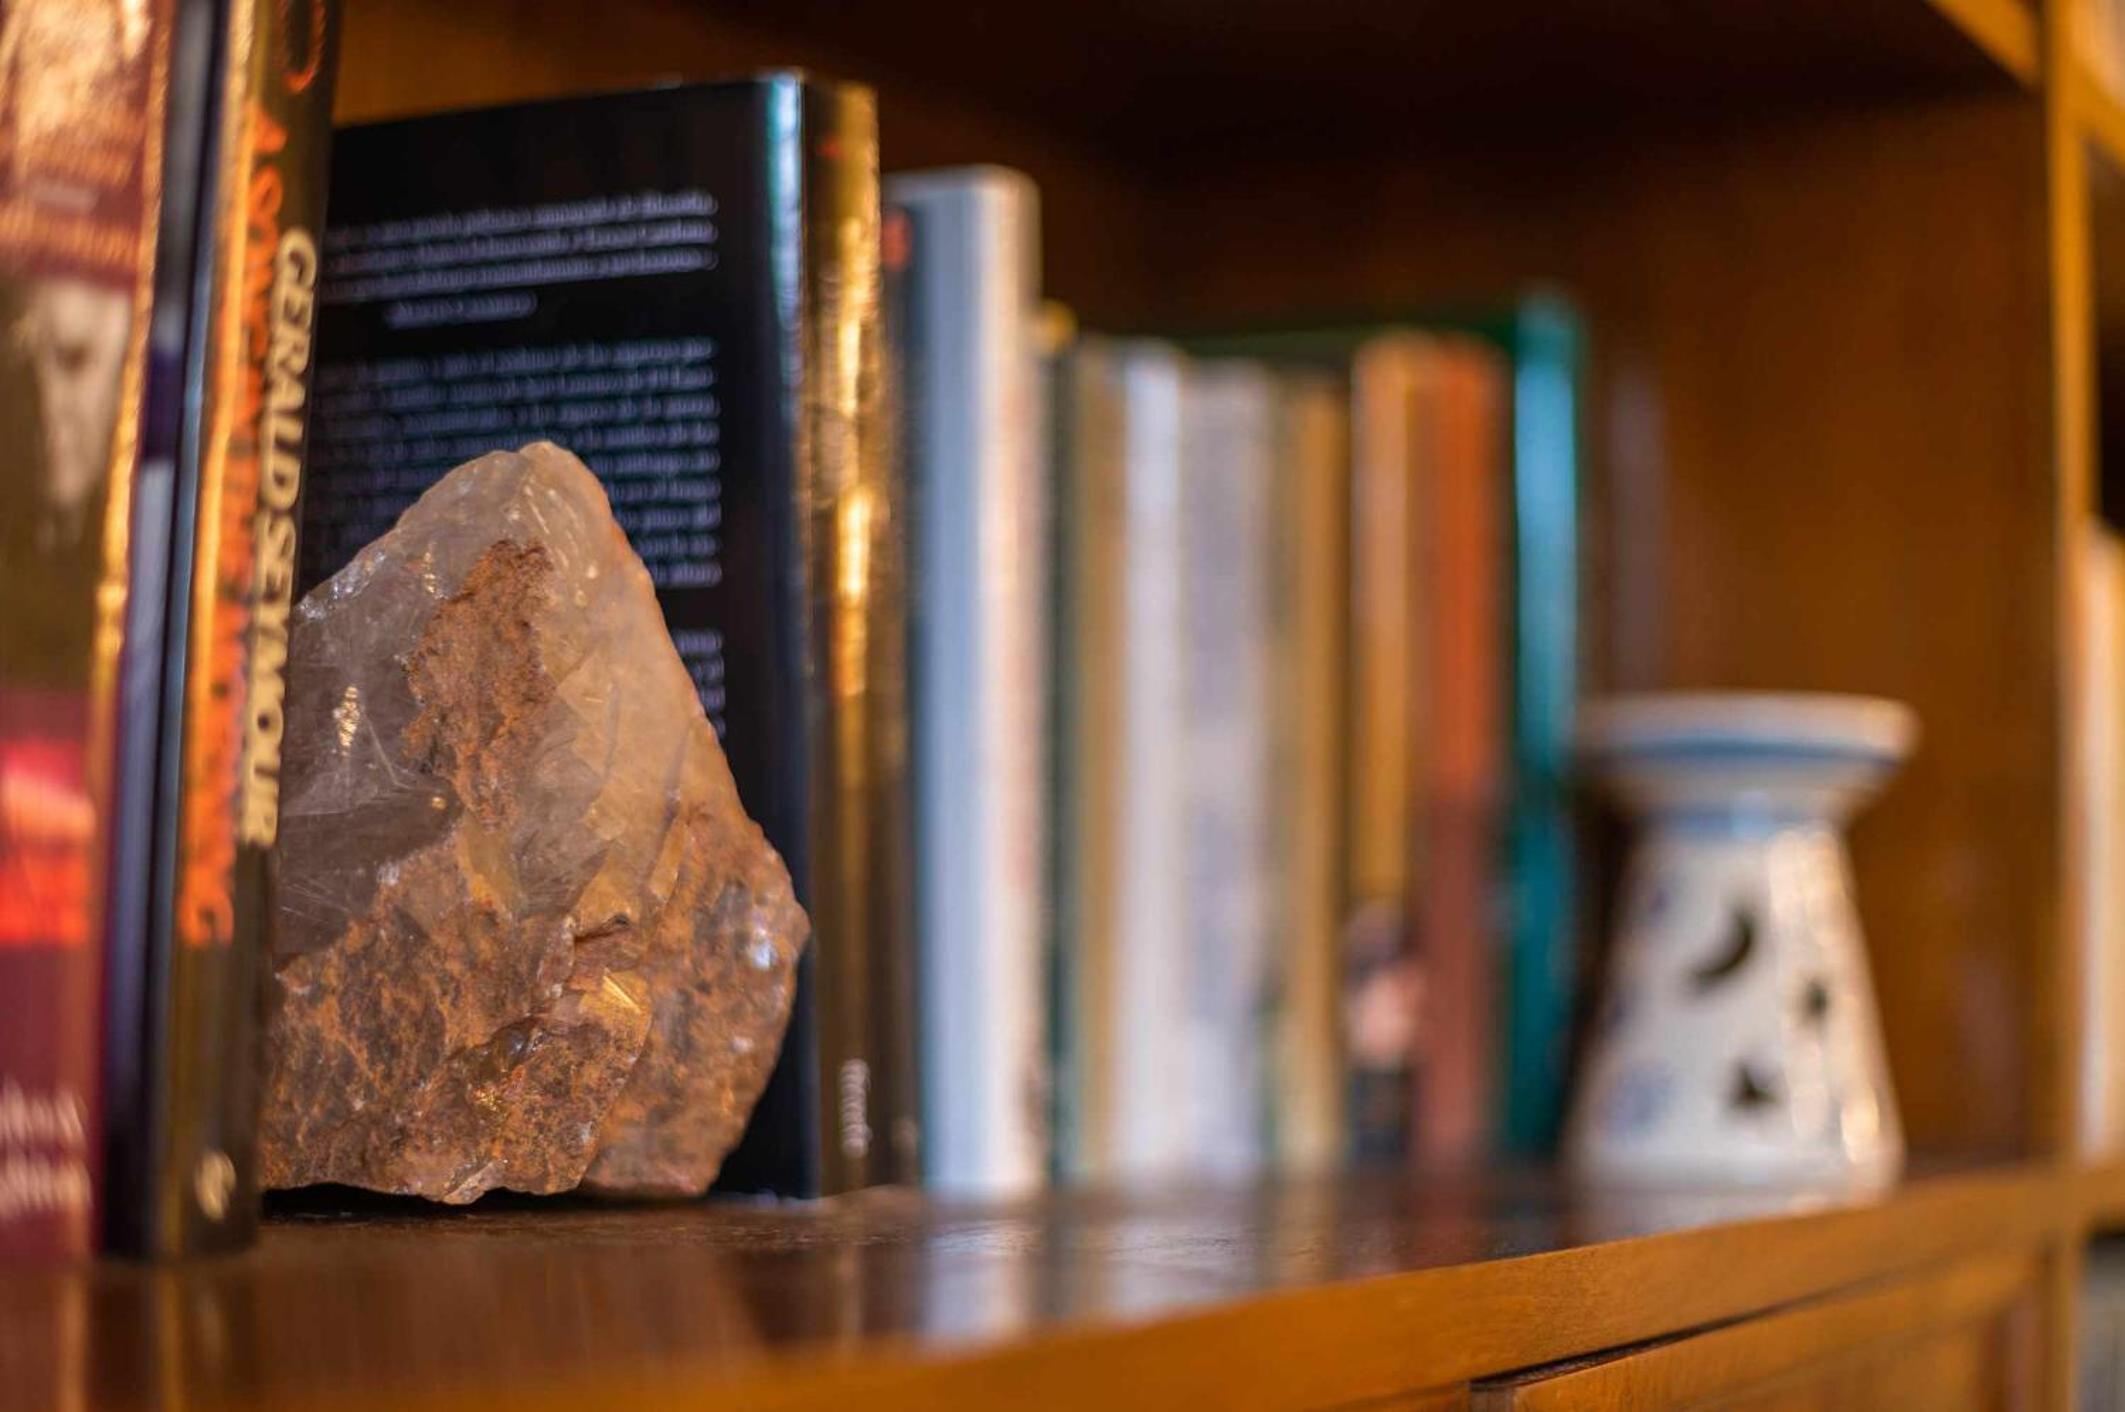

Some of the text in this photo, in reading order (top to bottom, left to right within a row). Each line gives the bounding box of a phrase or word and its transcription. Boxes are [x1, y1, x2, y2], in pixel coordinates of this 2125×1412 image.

[178, 596, 251, 946] MORNING
[241, 227, 317, 847] GERALD SEYMOUR
